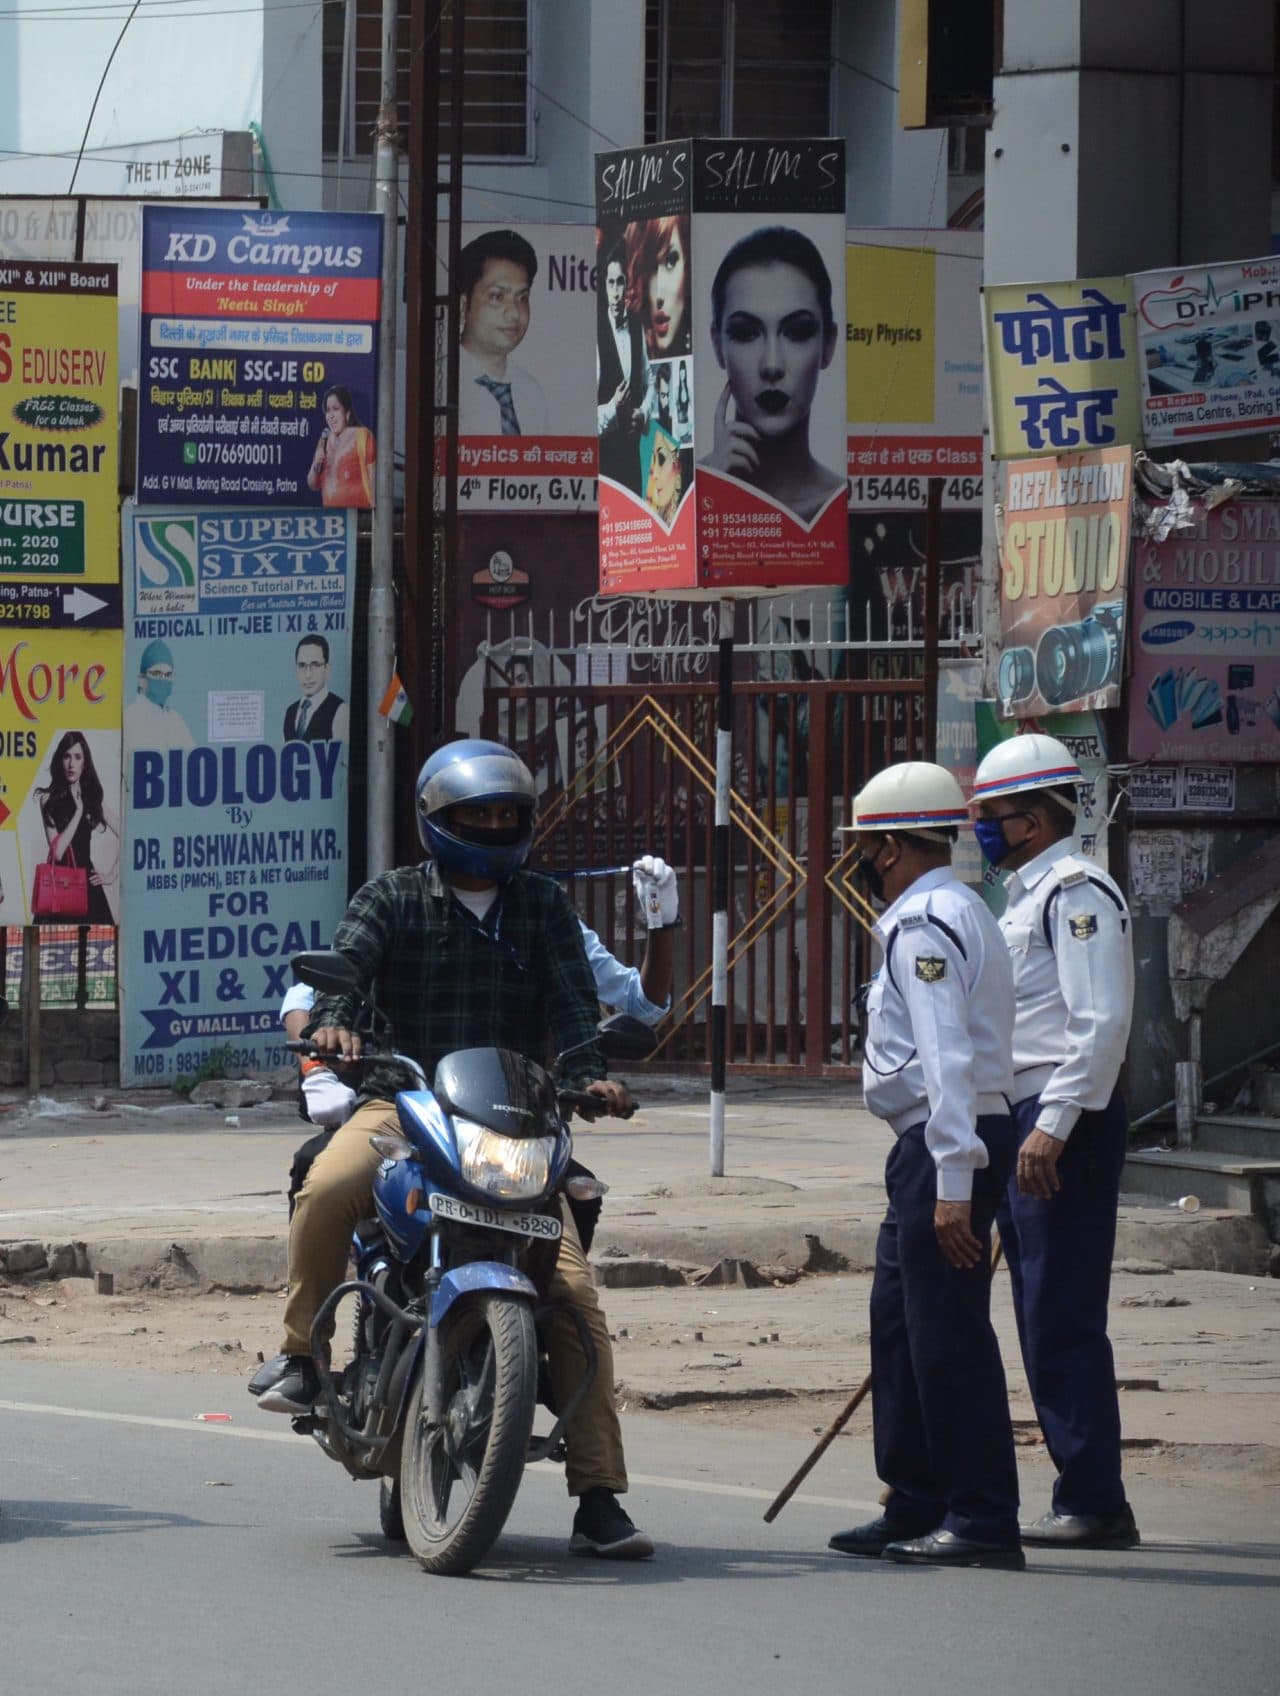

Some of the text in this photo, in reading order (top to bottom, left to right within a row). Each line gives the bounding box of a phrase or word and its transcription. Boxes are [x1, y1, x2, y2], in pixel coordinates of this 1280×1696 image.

[126, 154, 211, 183] THE IT ZONE
[164, 232, 363, 274] KD Campus
[24, 271, 35, 286] &
[70, 272, 109, 289] Board
[185, 277, 338, 297] Under the leadership of
[1176, 301, 1215, 319] Dr.
[846, 323, 922, 346] Easy Physics
[994, 288, 1127, 366] फोटो
[22, 348, 107, 386] EDUSERV
[149, 358, 325, 383] SSC BANK SSC-JE GD
[1014, 377, 1118, 449] स्टेट
[1196, 406, 1236, 422] Centre,
[1239, 399, 1274, 416] Boring
[198, 444, 282, 464] 07766900011
[458, 446, 519, 469] hysics
[523, 445, 541, 465] की
[581, 449, 594, 466] से
[143, 475, 160, 489] Add.
[178, 477, 194, 491] Mall,
[197, 478, 219, 493] Boring
[221, 480, 241, 491] Road
[243, 480, 274, 495] Crossing,
[276, 482, 297, 493] Patna
[488, 478, 542, 505] Floor,
[548, 478, 586, 500] G.V.
[1008, 463, 1125, 511] REFLECTION
[200, 514, 346, 544] SUPERB
[22, 535, 59, 549] 2020
[22, 553, 59, 567] 2020
[202, 549, 345, 578] SIXTY
[1004, 511, 1120, 600] STUDIO
[204, 576, 342, 594] Science Tutorial Pvt. Ltd.
[1153, 591, 1222, 609] MOBILE
[1228, 592, 1241, 609] &
[134, 612, 345, 639] MEDICAL IIT-JEE XI & XII
[132, 740, 342, 809] BIOLOGY
[1132, 774, 1171, 784] TO-LET
[1190, 774, 1228, 784] TO-LET
[225, 806, 253, 828] By
[133, 827, 343, 871] DR. BISHWANATH KR.
[147, 873, 178, 891] MBBS
[180, 869, 222, 892] (PMCH),
[249, 869, 257, 885] &
[261, 868, 281, 885] NET
[284, 865, 329, 884] Qualified
[208, 891, 269, 918] FOR
[143, 920, 333, 964] MEDICAL
[158, 970, 200, 1005] XI
[216, 967, 247, 1002] &
[170, 1013, 271, 1036] GV MALL, LG
[521, 1217, 559, 1236] 5280
